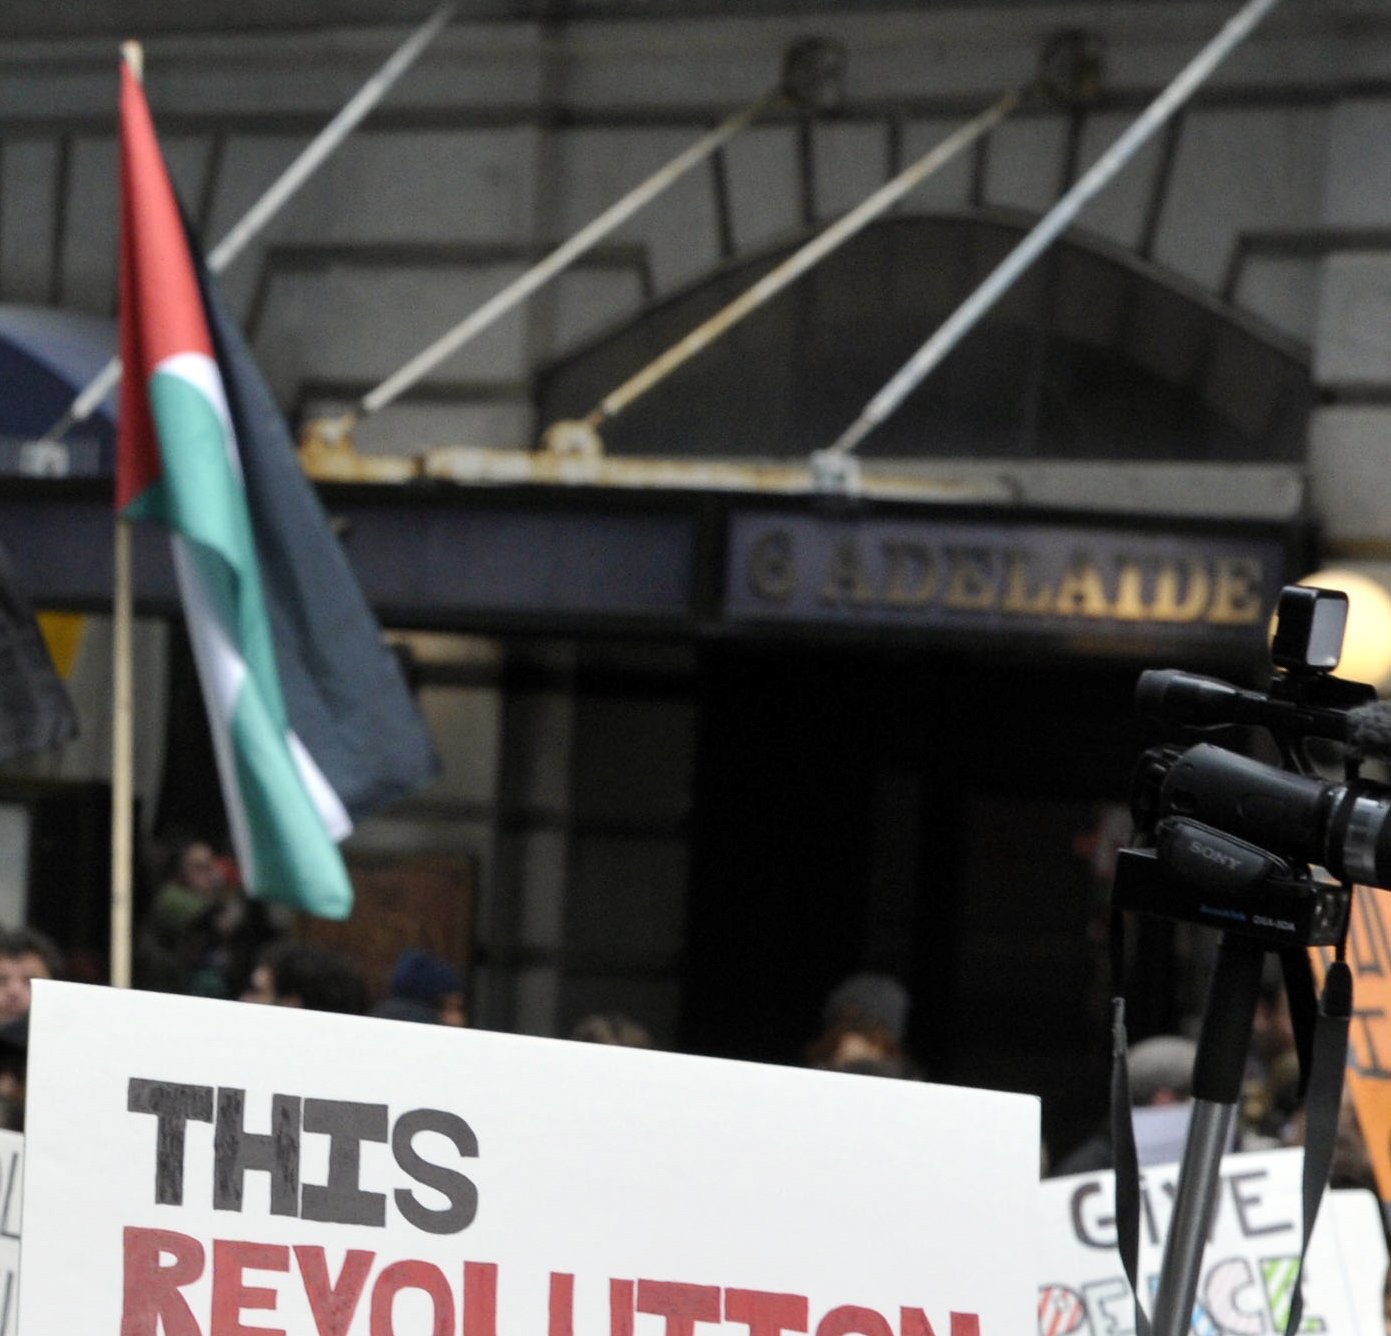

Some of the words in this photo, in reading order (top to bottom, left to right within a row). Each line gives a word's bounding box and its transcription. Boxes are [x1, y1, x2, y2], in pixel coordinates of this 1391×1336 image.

[818, 530, 1263, 625] ADELAIDE
[1189, 839, 1243, 869] SONY
[127, 1077, 479, 1234] THIS
